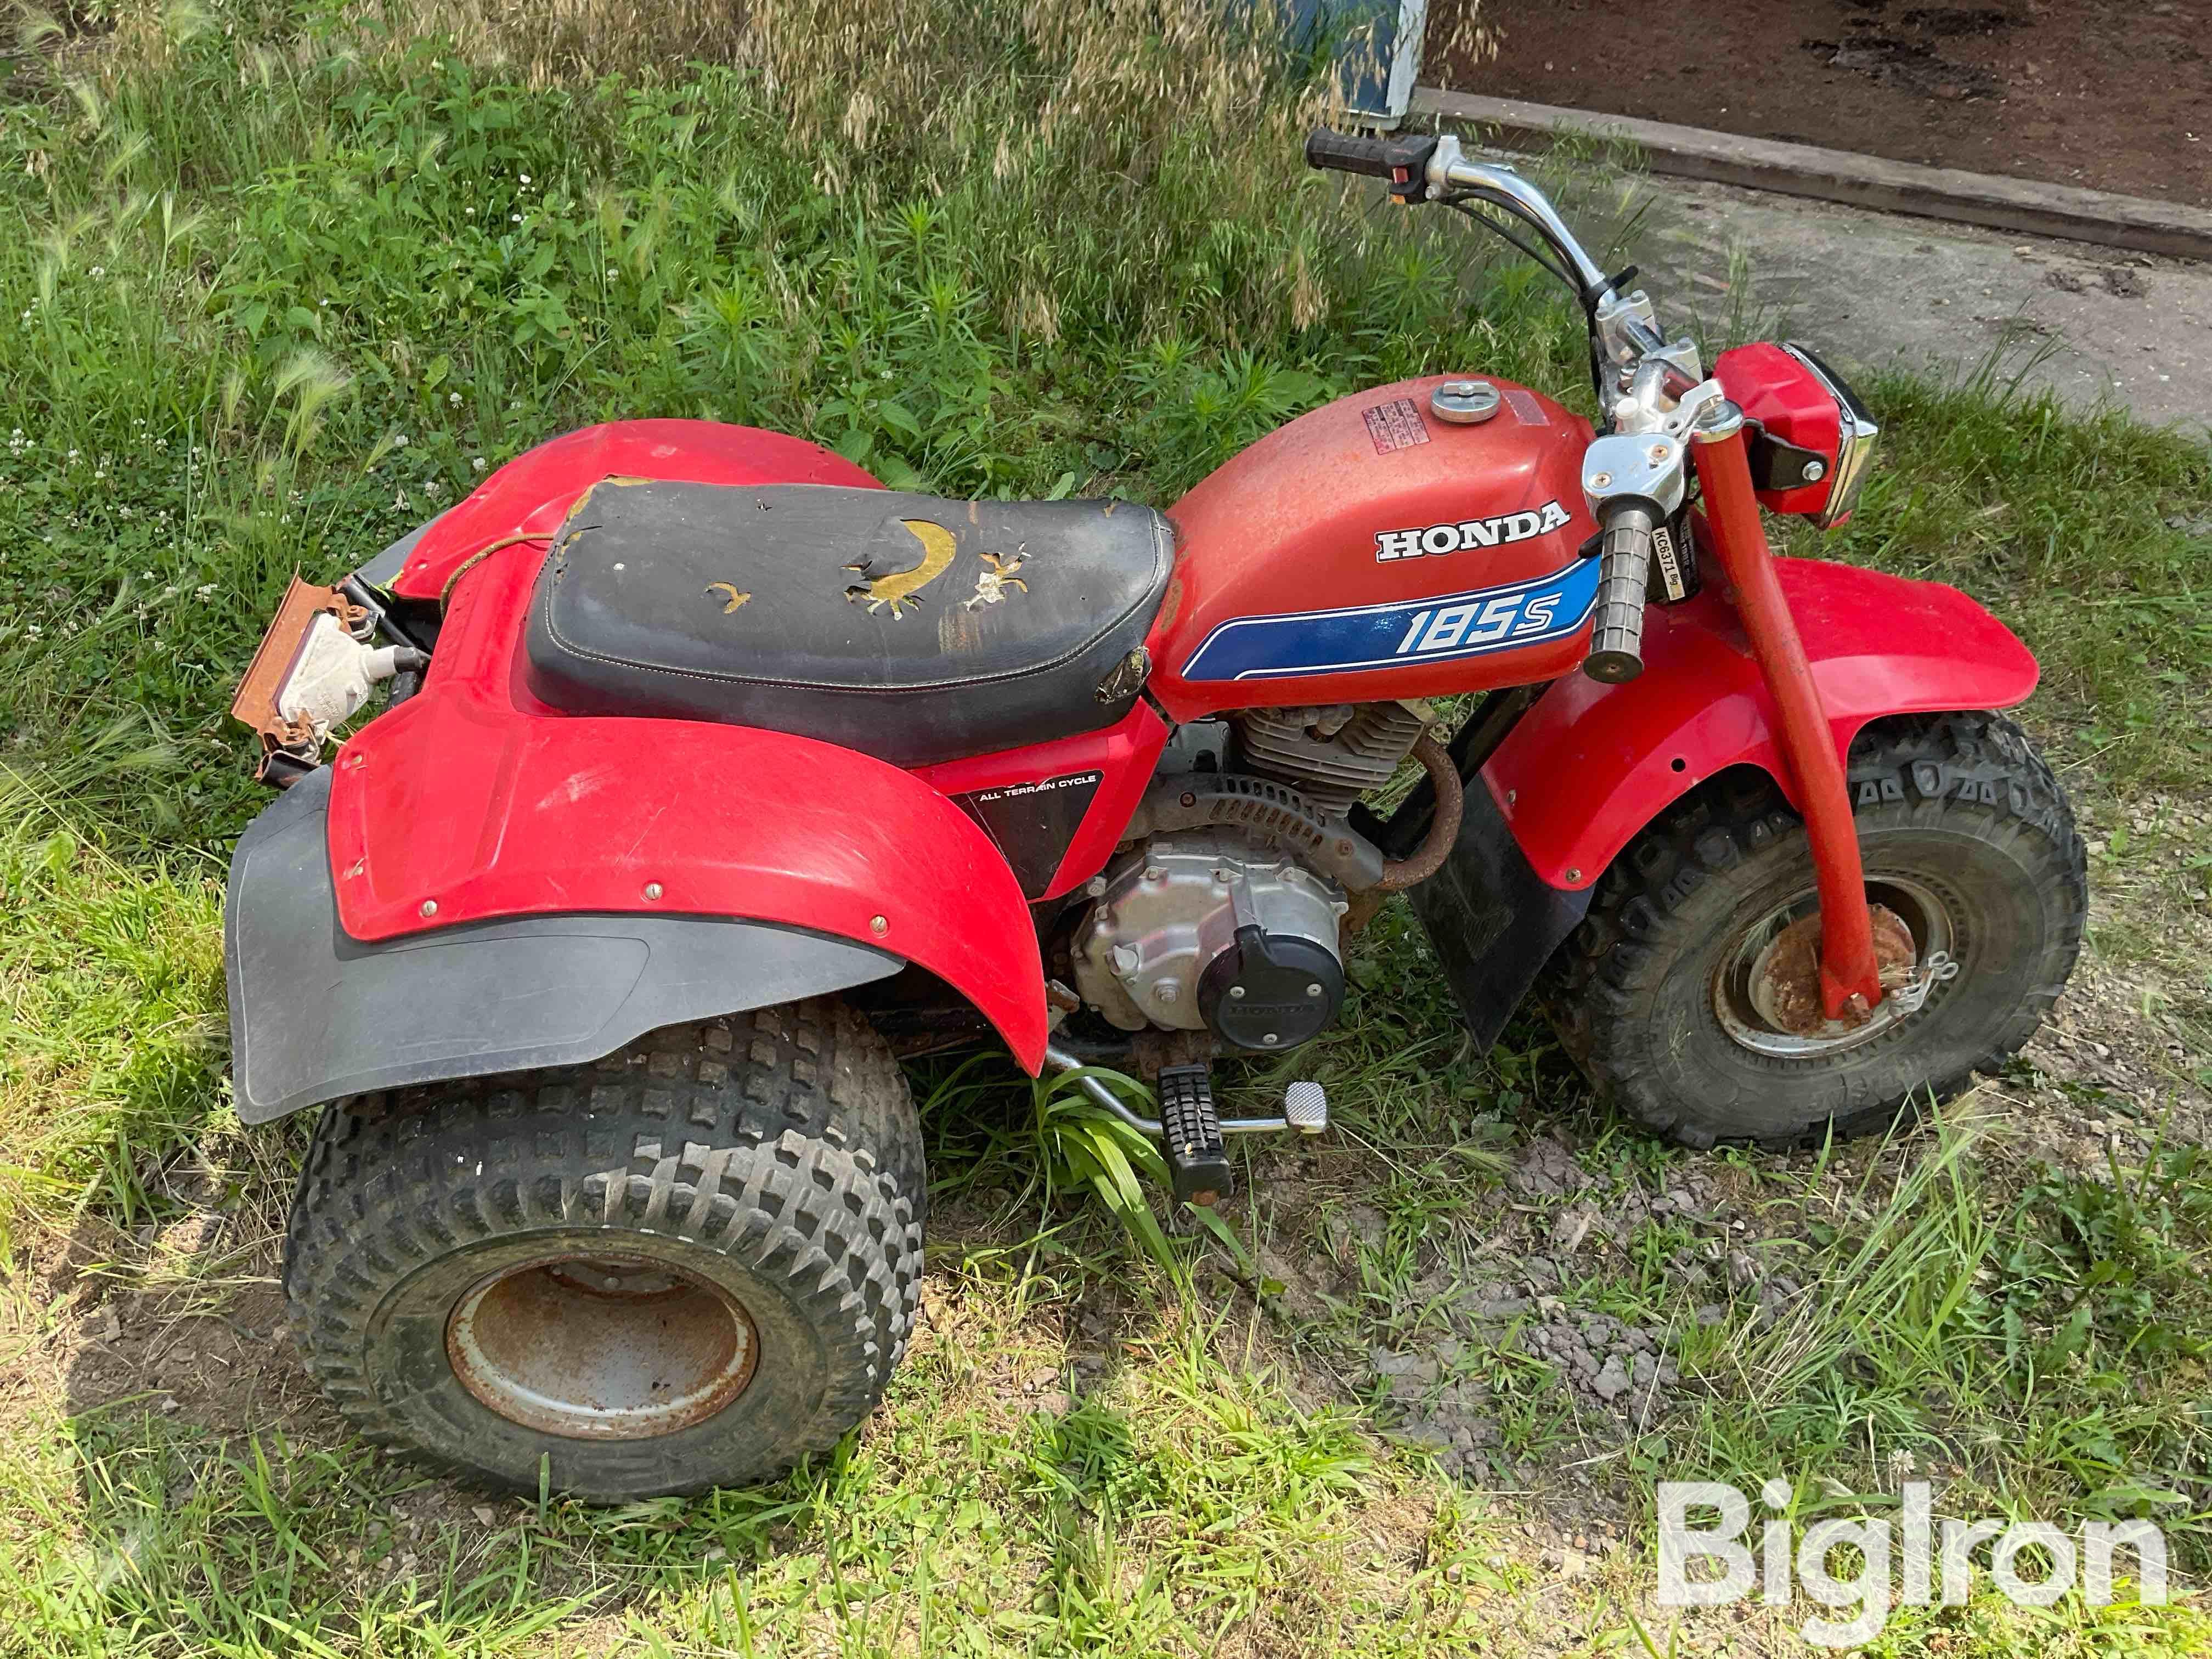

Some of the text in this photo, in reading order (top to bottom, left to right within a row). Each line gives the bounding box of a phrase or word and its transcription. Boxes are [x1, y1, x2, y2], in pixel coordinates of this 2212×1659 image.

[1377, 500, 1571, 560] HONDA
[1655, 531, 1675, 573] KC6371
[1004, 782, 1056, 797] TERRAIN
[1059, 775, 1096, 787] CYCLE
